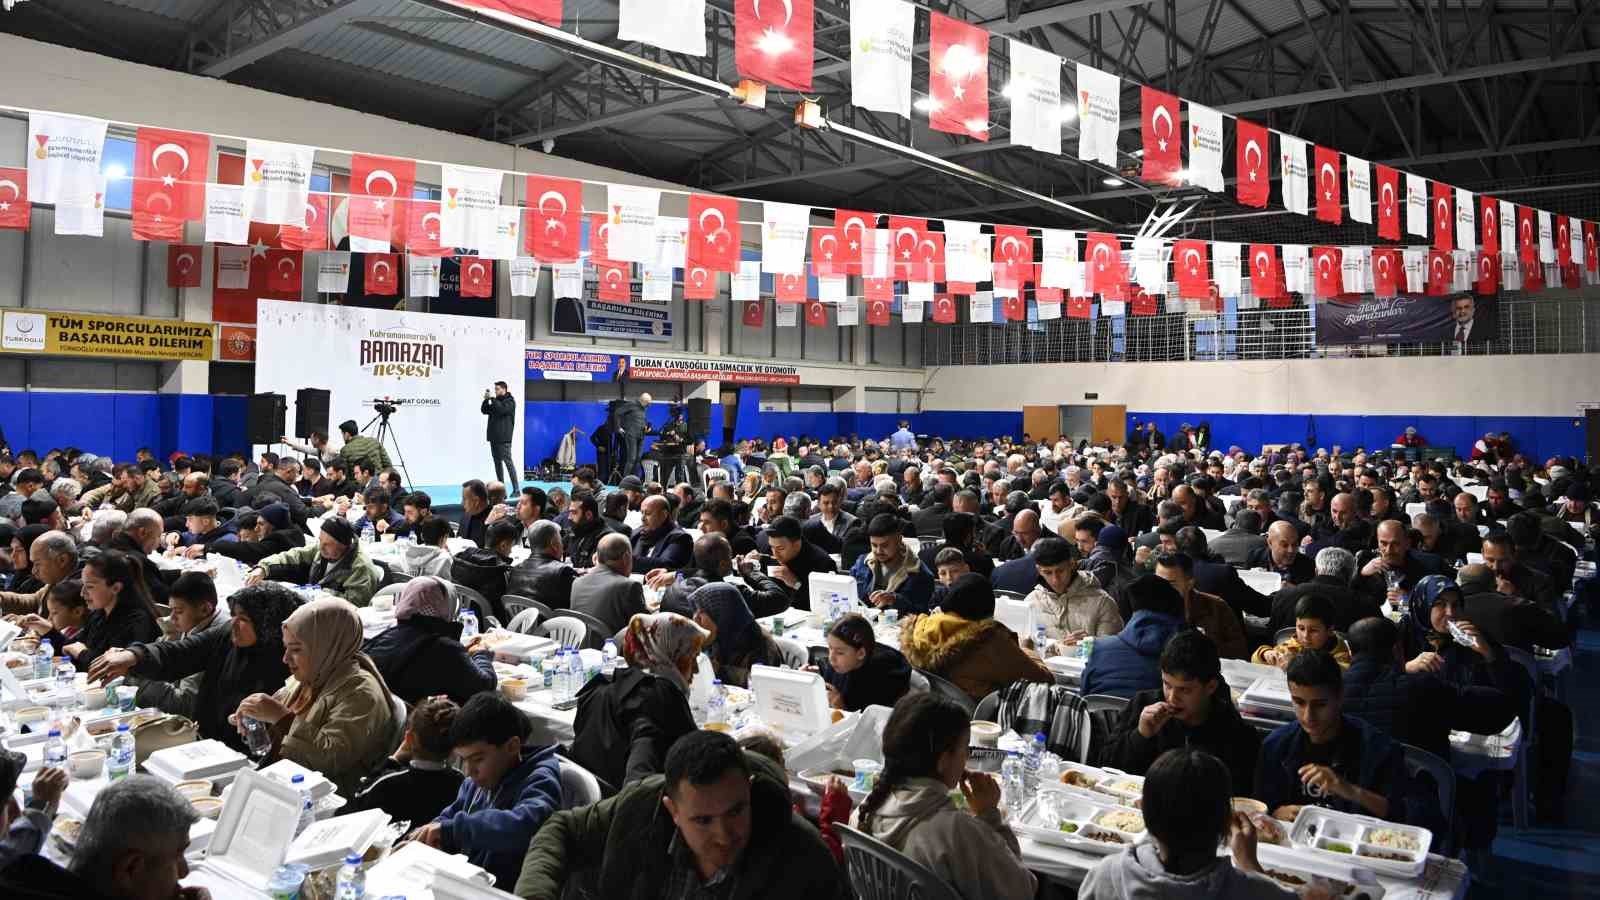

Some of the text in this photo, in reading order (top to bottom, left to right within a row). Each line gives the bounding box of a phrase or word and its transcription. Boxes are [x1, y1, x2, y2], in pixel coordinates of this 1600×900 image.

[50, 315, 212, 337] TÜM SPORCULARIMIZA
[59, 332, 203, 349] BAŞARILAR DİLERİM
[360, 339, 444, 369] RAMAZAN
[634, 359, 662, 368] DURAN
[373, 361, 431, 380] neşesi
